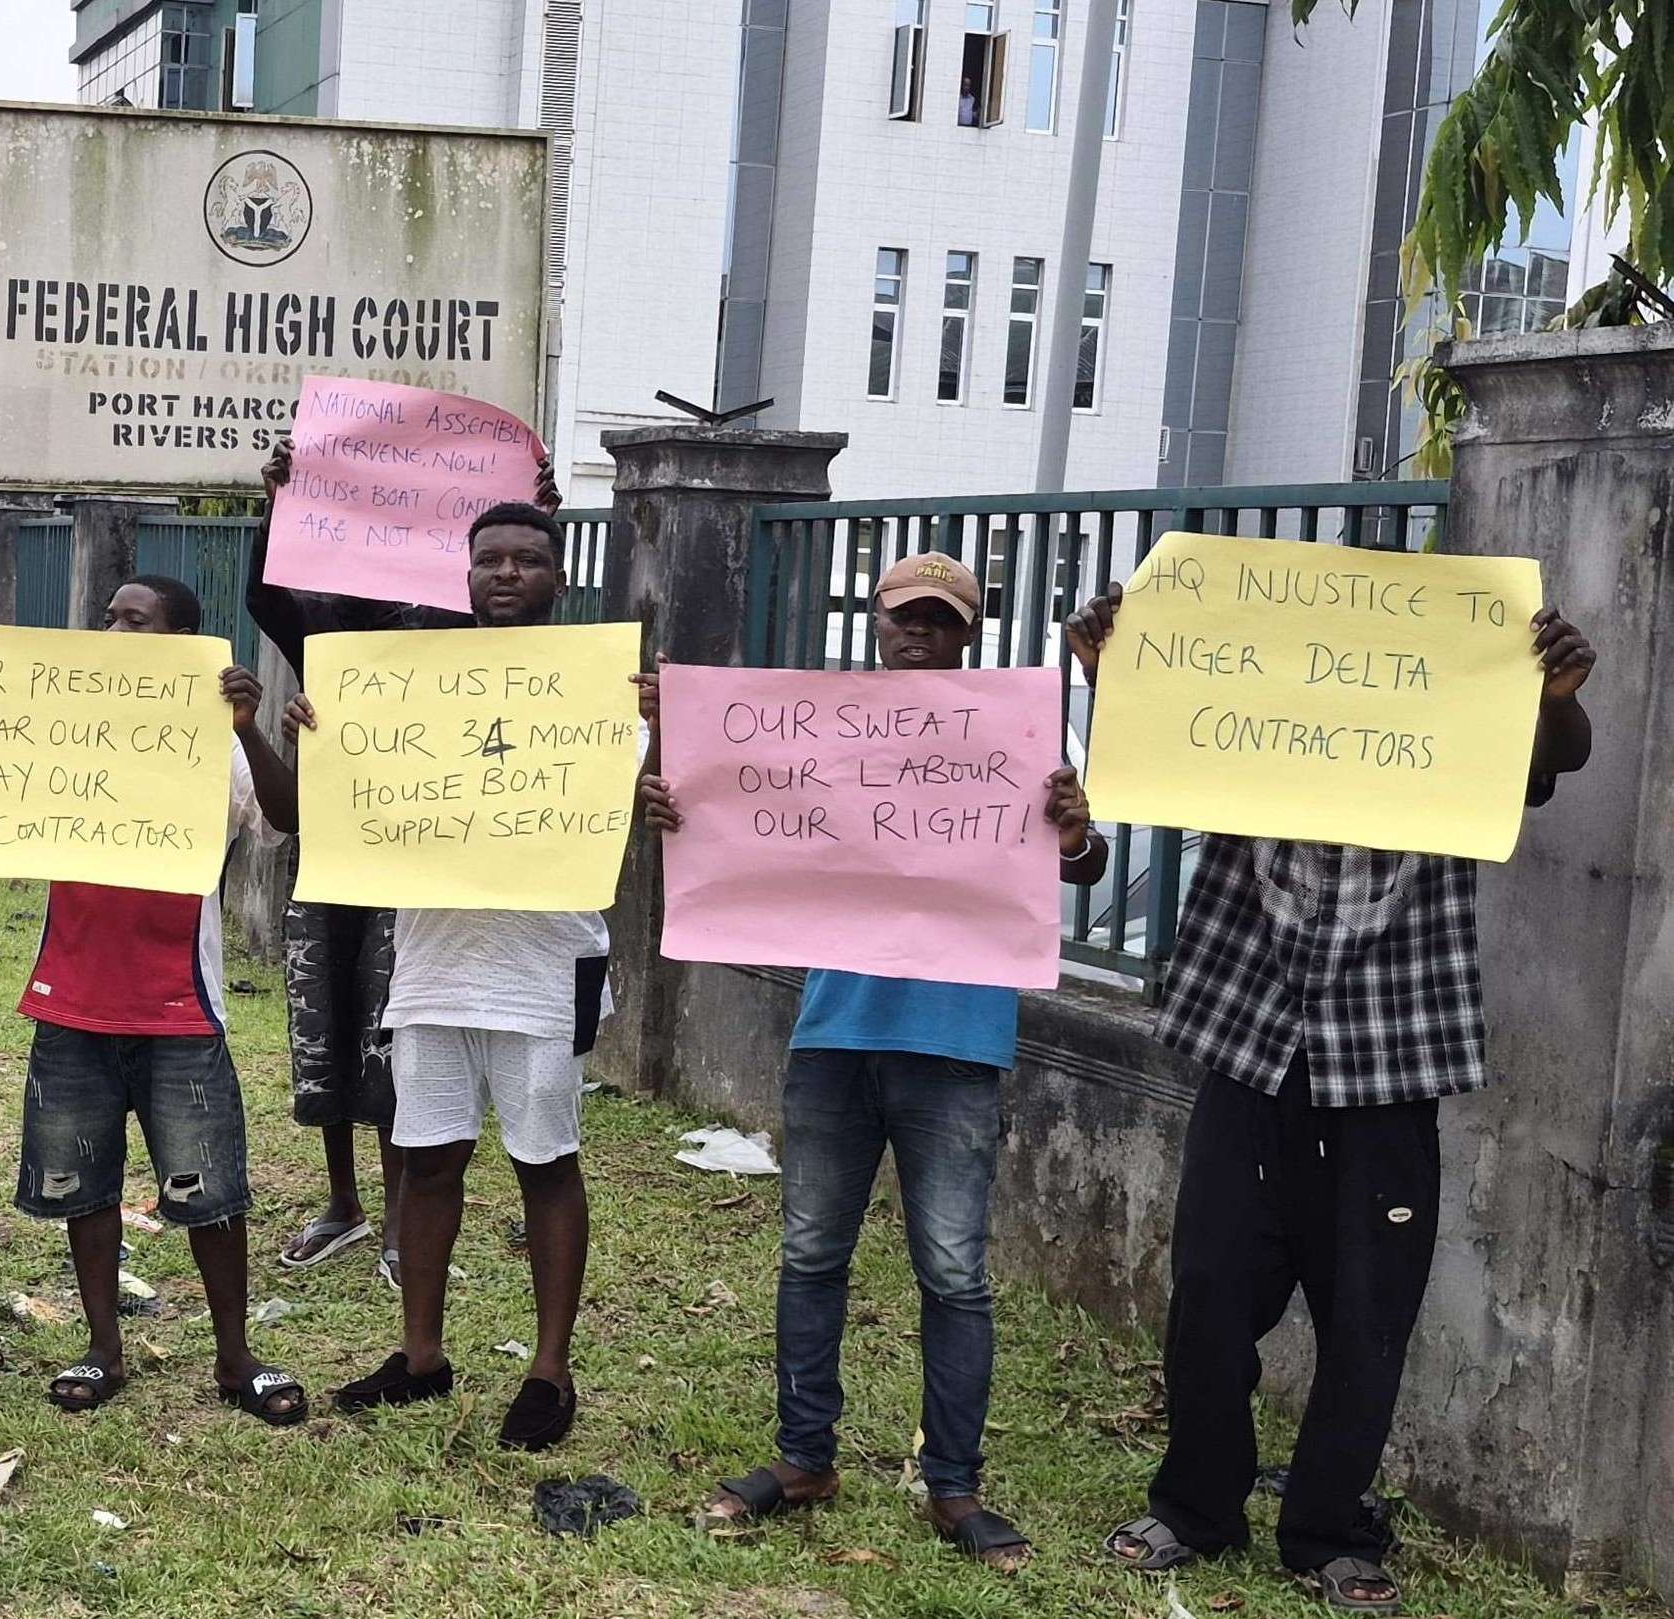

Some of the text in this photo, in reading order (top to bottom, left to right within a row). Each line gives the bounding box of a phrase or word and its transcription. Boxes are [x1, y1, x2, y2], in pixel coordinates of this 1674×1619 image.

[7, 278, 500, 361] FEDERAL HIGH COURT
[35, 349, 186, 380] STATION
[220, 360, 350, 385] OKRI
[88, 391, 180, 418] PORT
[310, 391, 406, 425] NATIONAL
[112, 424, 239, 450] RIVERS
[433, 450, 496, 475] NOW!
[372, 485, 427, 507] BOAT
[300, 512, 348, 542] ARE
[366, 525, 413, 547] NOT
[1237, 563, 1428, 617] INJUSTICE
[1456, 591, 1506, 627] TO
[1135, 631, 1433, 691] NIGER DELTA
[30, 662, 200, 707] PRESIDENT
[337, 667, 565, 702] PAY US FOR
[340, 716, 633, 765] OUR 34 MONTHS
[723, 700, 980, 743] OUR SWEAT
[1189, 706, 1436, 769] CONTRACTORS
[49, 719, 117, 752] OUR
[130, 724, 201, 768] CRY,
[48, 766, 118, 803] OUR
[352, 761, 576, 809] HOUSE BOAT
[739, 750, 1020, 793] OUR LABOUR
[359, 808, 630, 846] SUPPLY SERVICES
[754, 801, 1032, 844] OUR RIGHT!
